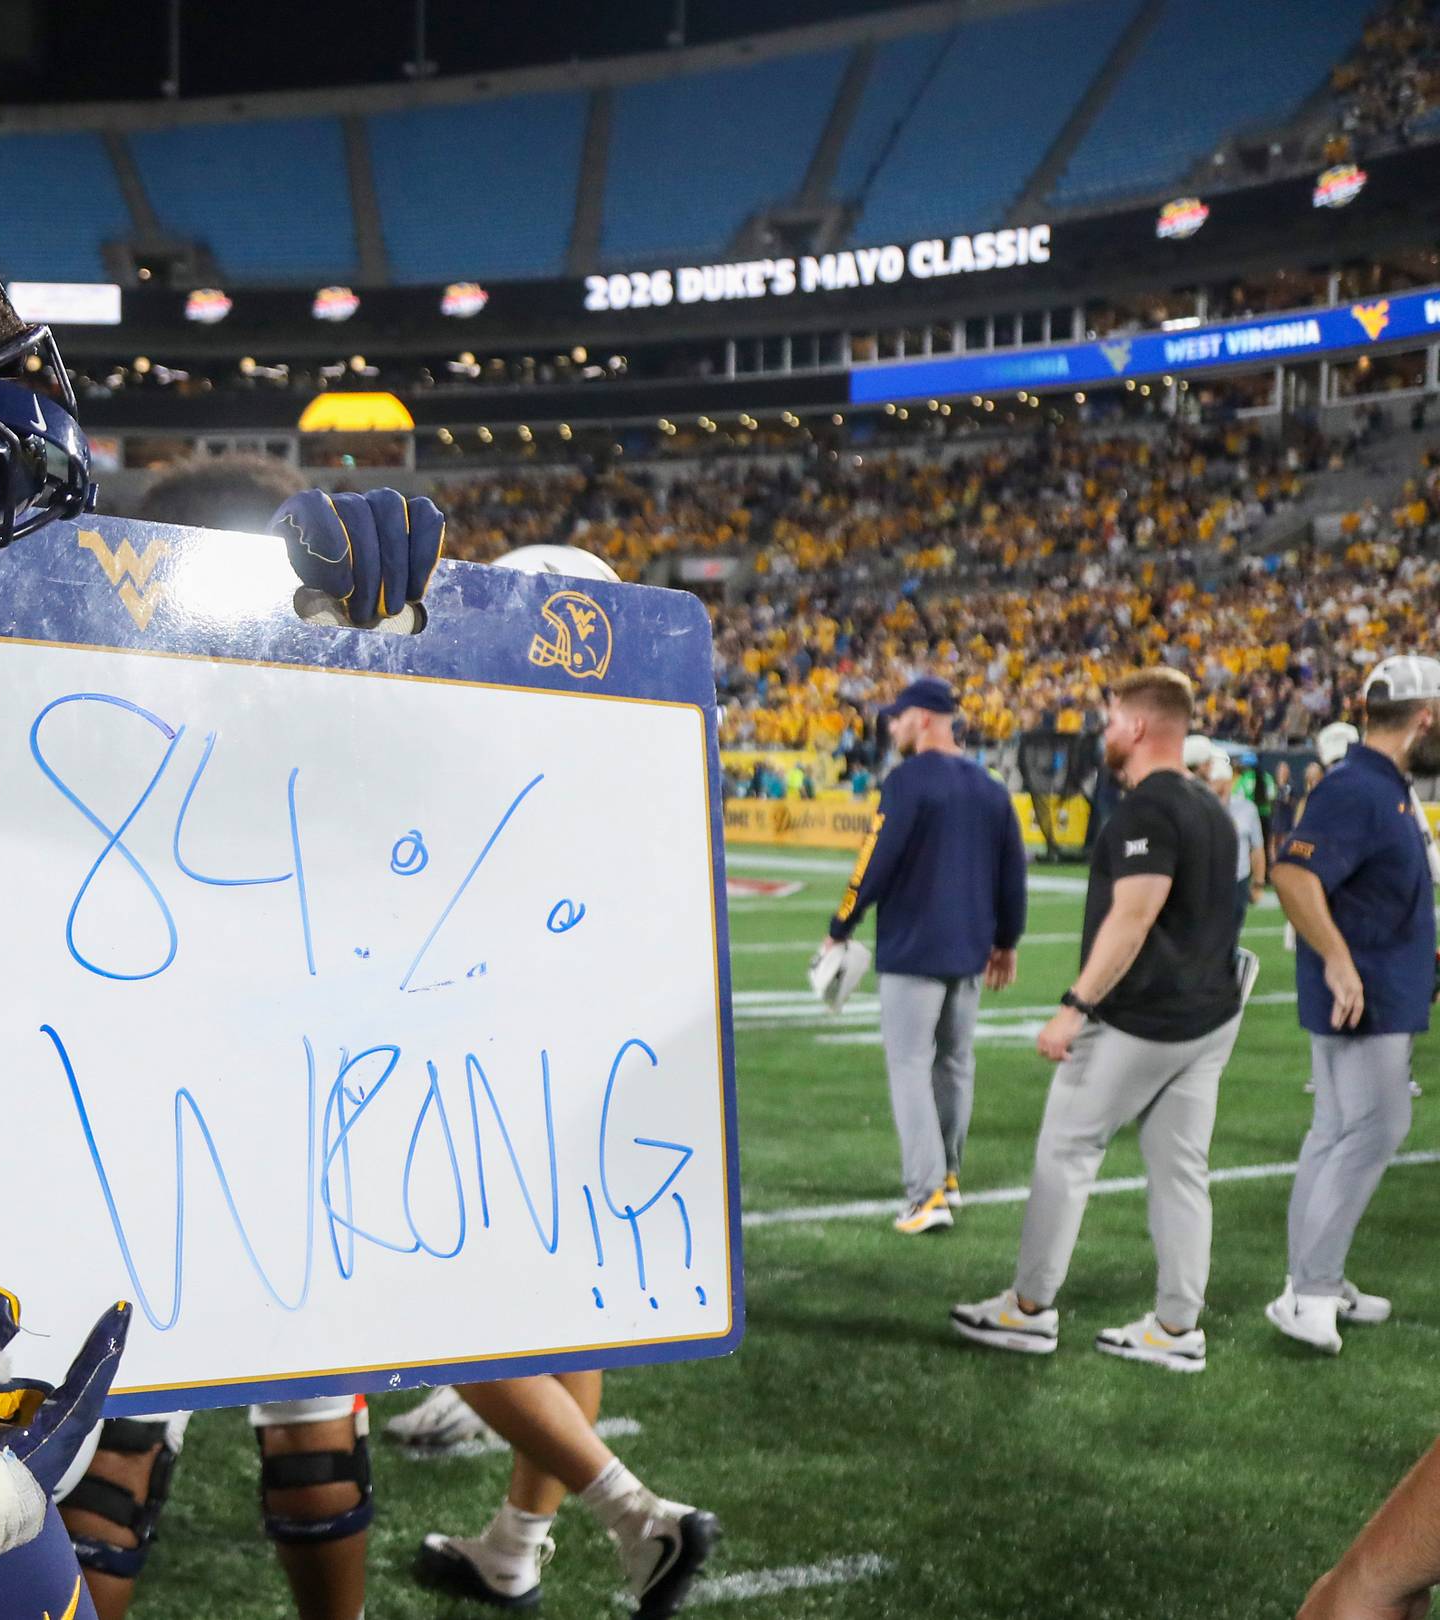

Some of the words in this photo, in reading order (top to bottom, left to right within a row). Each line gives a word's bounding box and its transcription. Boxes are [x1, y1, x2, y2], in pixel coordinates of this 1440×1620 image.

[584, 273, 674, 311] 2026
[677, 257, 797, 304] DUKE'S
[801, 245, 905, 293] MAYO
[908, 224, 1052, 280] CLASSIC
[1164, 333, 1221, 363] WEST
[1225, 319, 1322, 355] VIRGINIA
